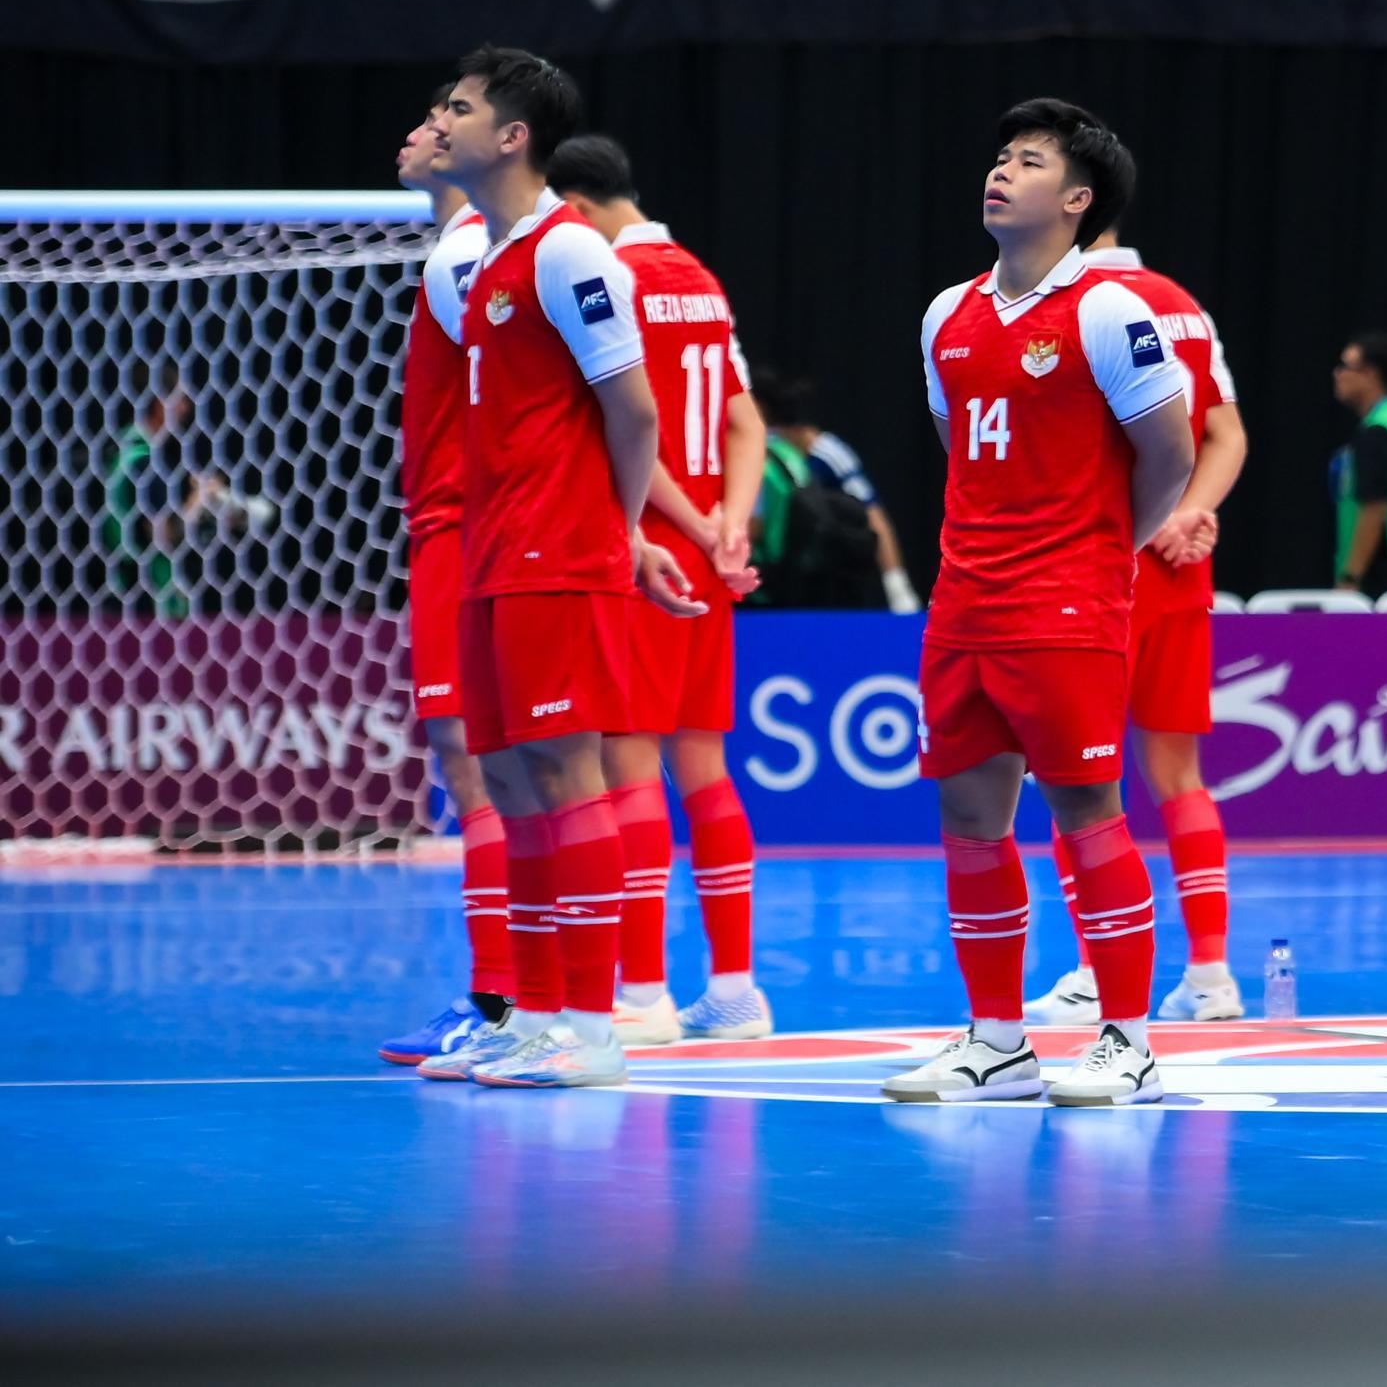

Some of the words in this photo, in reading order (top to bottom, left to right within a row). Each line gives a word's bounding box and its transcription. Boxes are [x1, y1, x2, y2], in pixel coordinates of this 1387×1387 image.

[580, 289, 607, 310] AFC
[1133, 333, 1159, 351] AFC
[939, 345, 971, 362] SPECS
[681, 343, 724, 476] 11
[965, 397, 1012, 461] 14
[418, 683, 452, 698] SPECS
[532, 699, 572, 717] SPECS
[54, 702, 411, 772] AIRWAYS
[1081, 743, 1117, 761] SPECS
